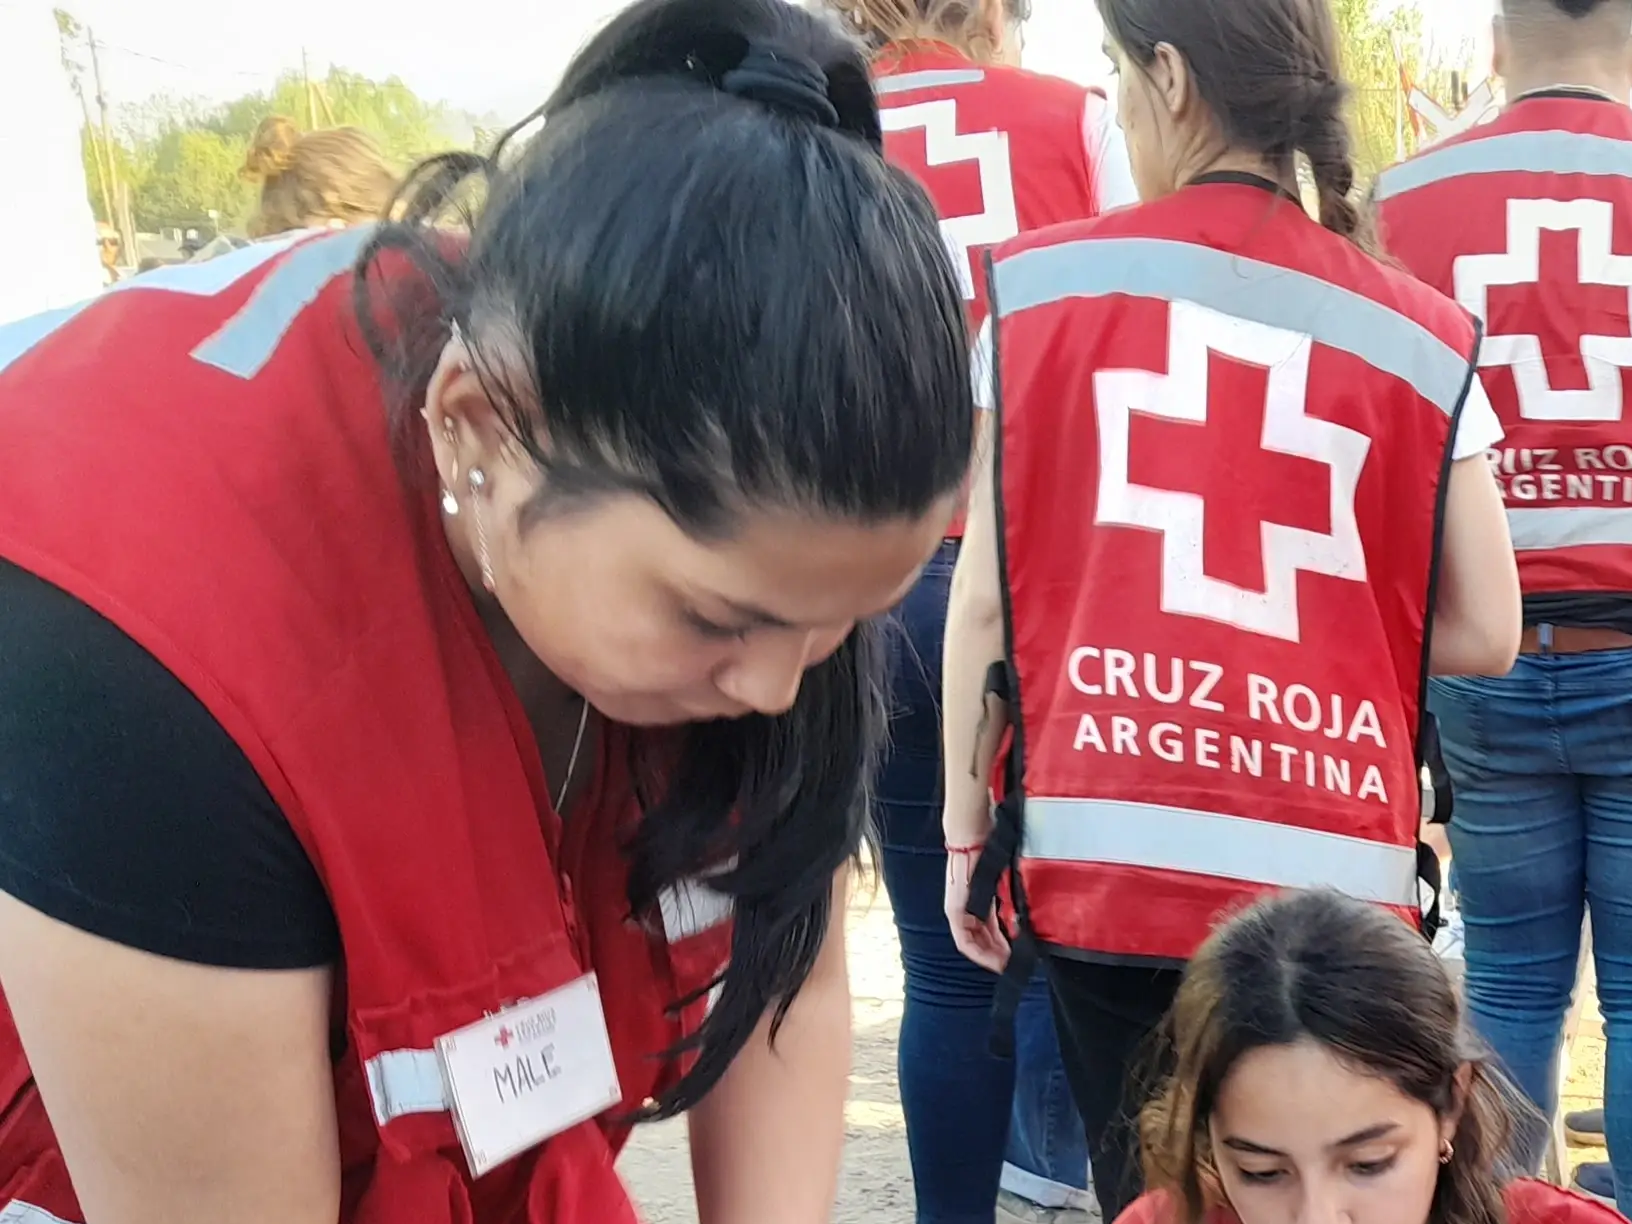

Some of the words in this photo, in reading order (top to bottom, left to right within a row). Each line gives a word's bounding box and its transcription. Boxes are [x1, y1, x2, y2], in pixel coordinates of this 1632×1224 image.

[1067, 645, 1225, 713] CRUZ
[1246, 672, 1388, 749] ROJA
[1072, 713, 1389, 804] ARGENTINA
[492, 1042, 562, 1104] MALE
